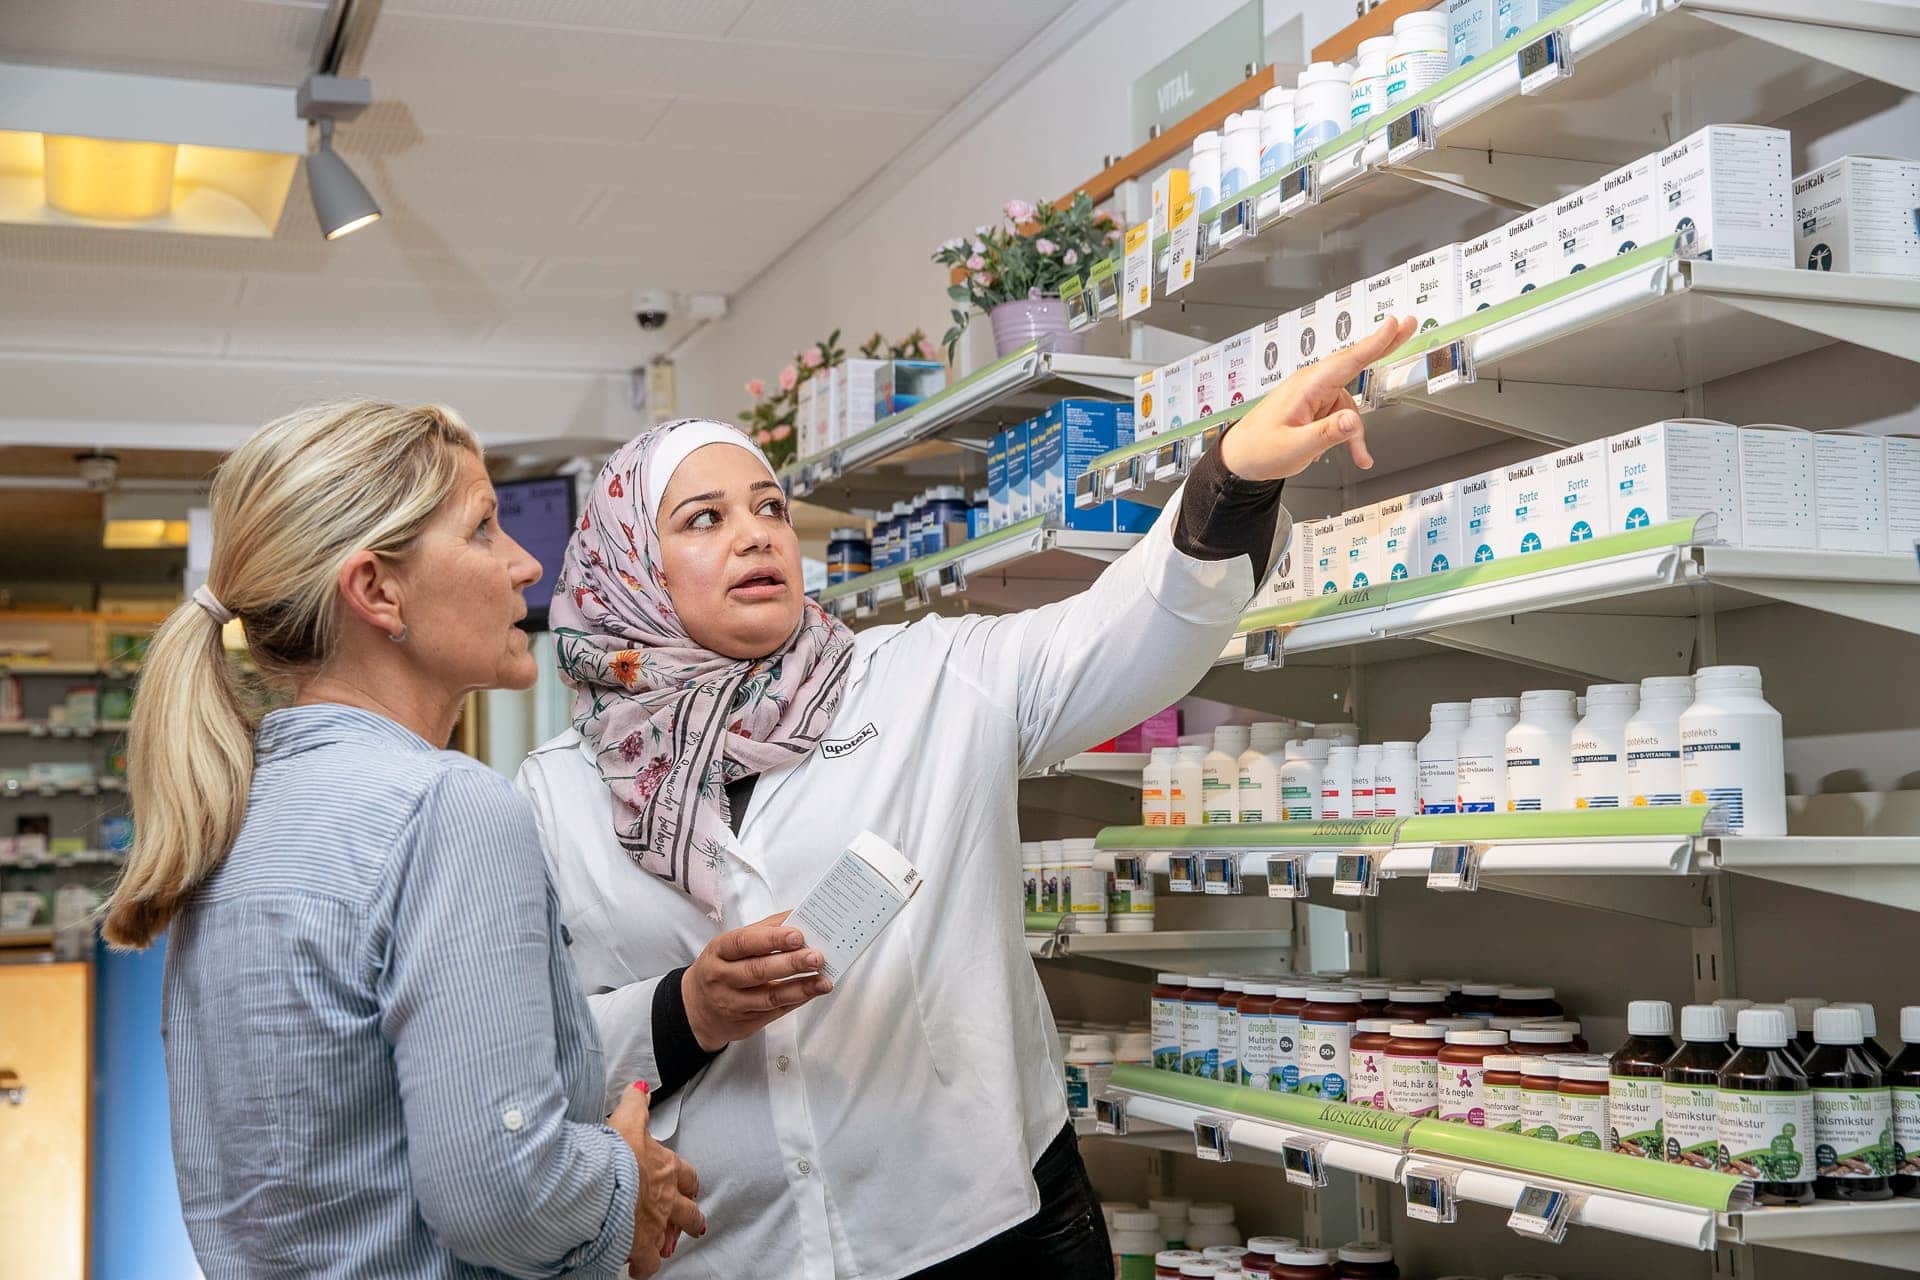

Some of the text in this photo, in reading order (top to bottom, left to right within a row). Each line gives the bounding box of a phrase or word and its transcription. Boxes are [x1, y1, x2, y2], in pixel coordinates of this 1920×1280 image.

[1157, 70, 1195, 114] VITAL
[1661, 144, 1689, 168] UniKalk
[1604, 170, 1634, 192] UniKalk
[1794, 173, 1826, 196] UniKalk
[1556, 196, 1585, 216] UniKalk
[1509, 218, 1535, 237] UniKalk
[1464, 239, 1489, 258] UniKalk
[1410, 256, 1436, 272] UniKalk
[1368, 276, 1391, 292] UniKalk
[1420, 278, 1439, 293] Basic
[1377, 297, 1395, 312] Basic
[1230, 357, 1244, 369] Extra
[1260, 371, 1282, 387] UniKalk
[1612, 436, 1642, 453] UniKalk
[1556, 452, 1584, 469] UniKalk
[1509, 465, 1535, 482] UniKalk
[1624, 461, 1647, 478] Forte
[1463, 480, 1487, 495] UniKalk
[1567, 477, 1589, 492] Forte
[1421, 492, 1444, 506] UniKalk
[1519, 490, 1539, 505] Forte
[1381, 503, 1403, 516] UniKalk
[1473, 503, 1491, 517] Forte
[1344, 514, 1365, 527] UniKalk
[1430, 515, 1447, 527] Forte
[1314, 523, 1334, 537] UniKalk
[1390, 525, 1407, 537] Forte
[1352, 535, 1368, 547] Forte
[1273, 580, 1295, 593] UniKalk
[825, 728, 873, 754] apotek
[1280, 1040, 1293, 1049] 50+
[1320, 1048, 1335, 1056] 50+
[1392, 1062, 1420, 1075] drogens
[1360, 1074, 1380, 1084] negle
[1393, 1079, 1434, 1089] Hud, hår &
[1452, 1089, 1474, 1097] negle
[1628, 1084, 1648, 1098] vital
[1692, 1091, 1713, 1107] vital
[1741, 1098, 1762, 1113] vital
[1850, 1096, 1872, 1112] vital
